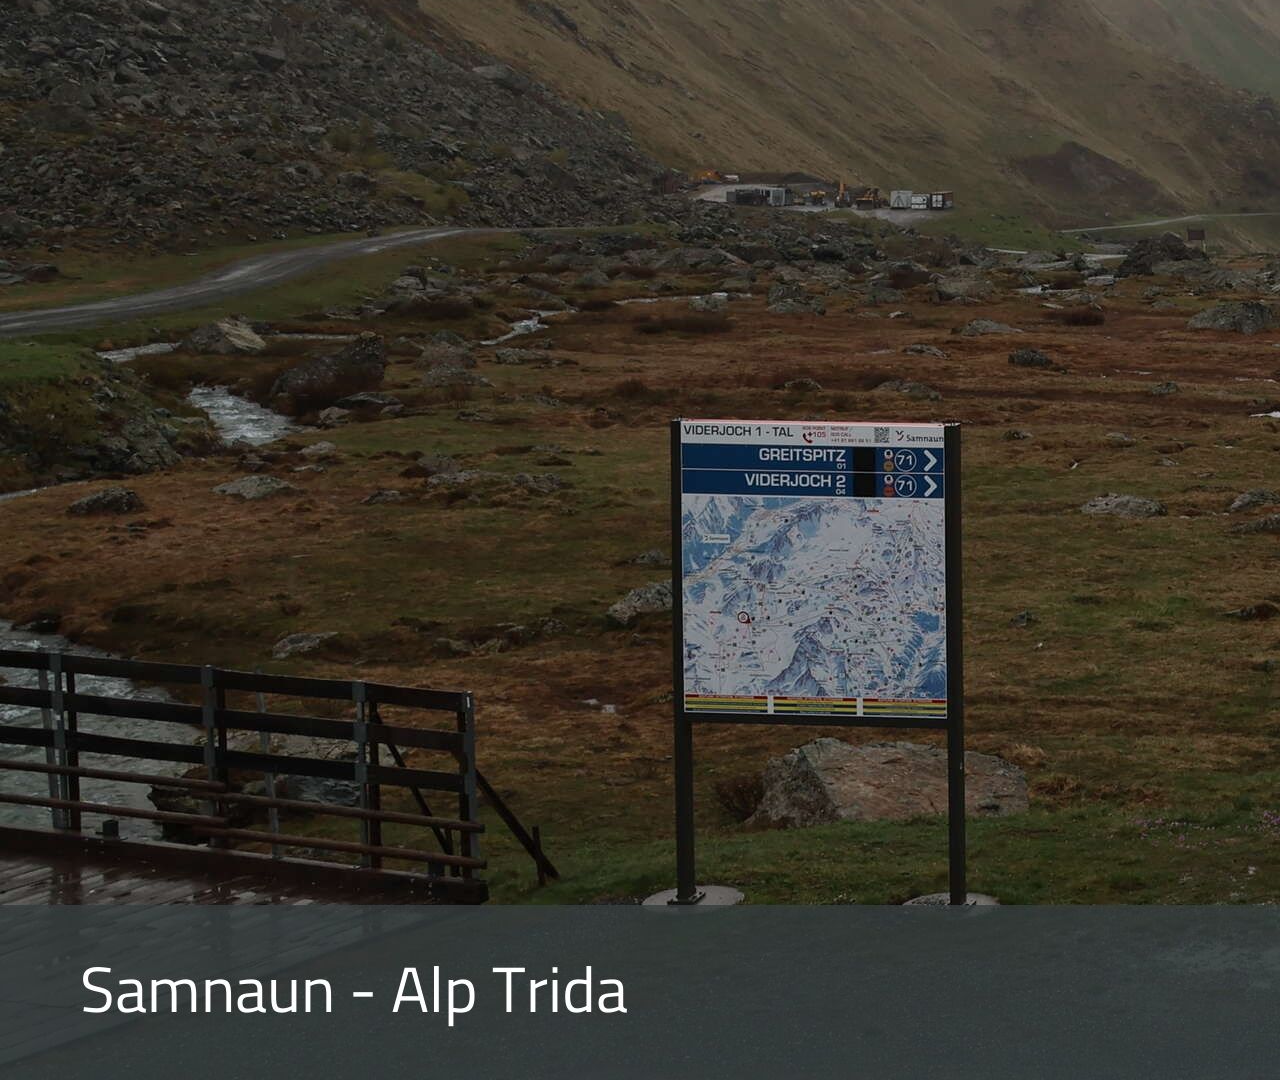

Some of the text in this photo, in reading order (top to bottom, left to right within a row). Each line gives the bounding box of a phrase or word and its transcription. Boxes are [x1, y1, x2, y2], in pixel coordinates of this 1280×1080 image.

[684, 425, 752, 436] VIDERJOCH
[755, 427, 761, 437] 1
[772, 427, 794, 438] TAL
[906, 434, 944, 443] Samnaun
[759, 448, 846, 462] GREITSPITZ
[897, 454, 913, 466] 71
[745, 473, 846, 488] VIDERJOCH 2
[897, 480, 913, 491] 71
